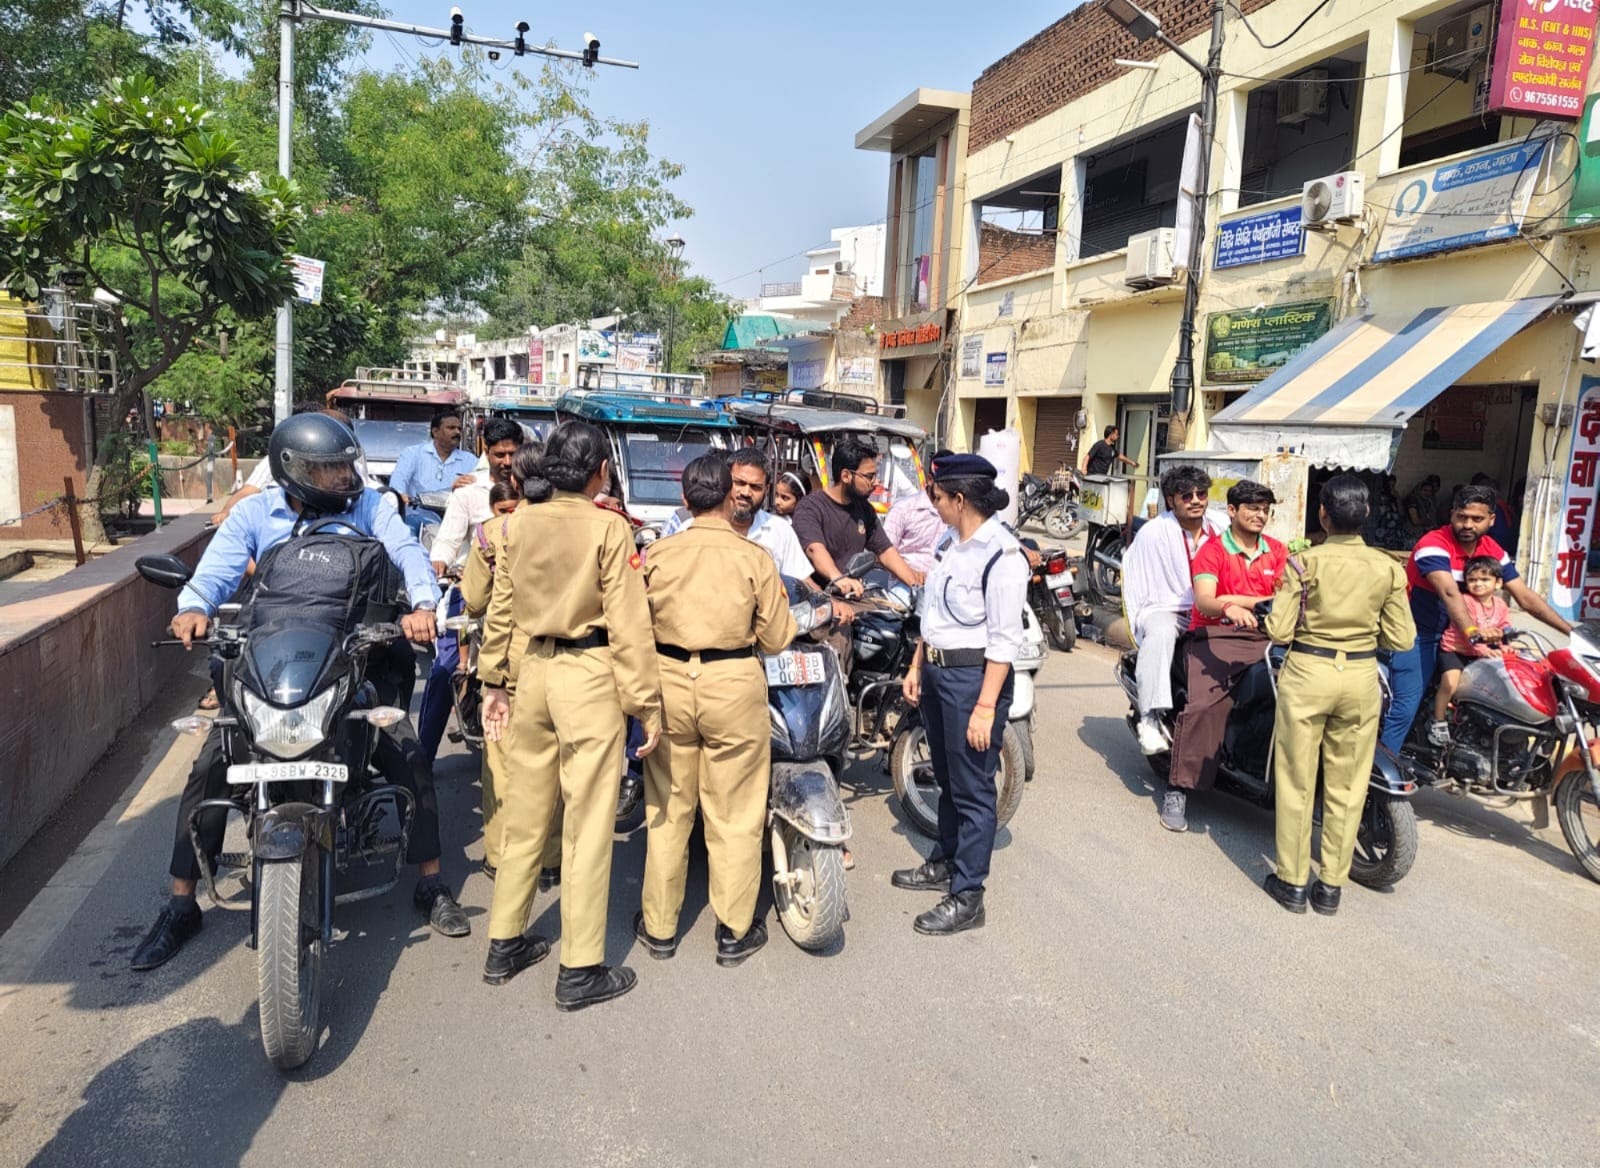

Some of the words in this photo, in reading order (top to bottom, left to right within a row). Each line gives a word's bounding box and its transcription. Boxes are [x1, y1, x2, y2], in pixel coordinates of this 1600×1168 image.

[1519, 17, 1539, 31] M.S.
[1541, 20, 1561, 34] (ENT
[1562, 23, 1570, 35] &
[1518, 36, 1540, 50] नाक,
[1543, 40, 1565, 54] कान,
[1567, 43, 1586, 57] गला
[1524, 90, 1579, 109] 9675561555
[1231, 317, 1261, 330] गणेश
[1264, 311, 1317, 326] प्लास्टिक
